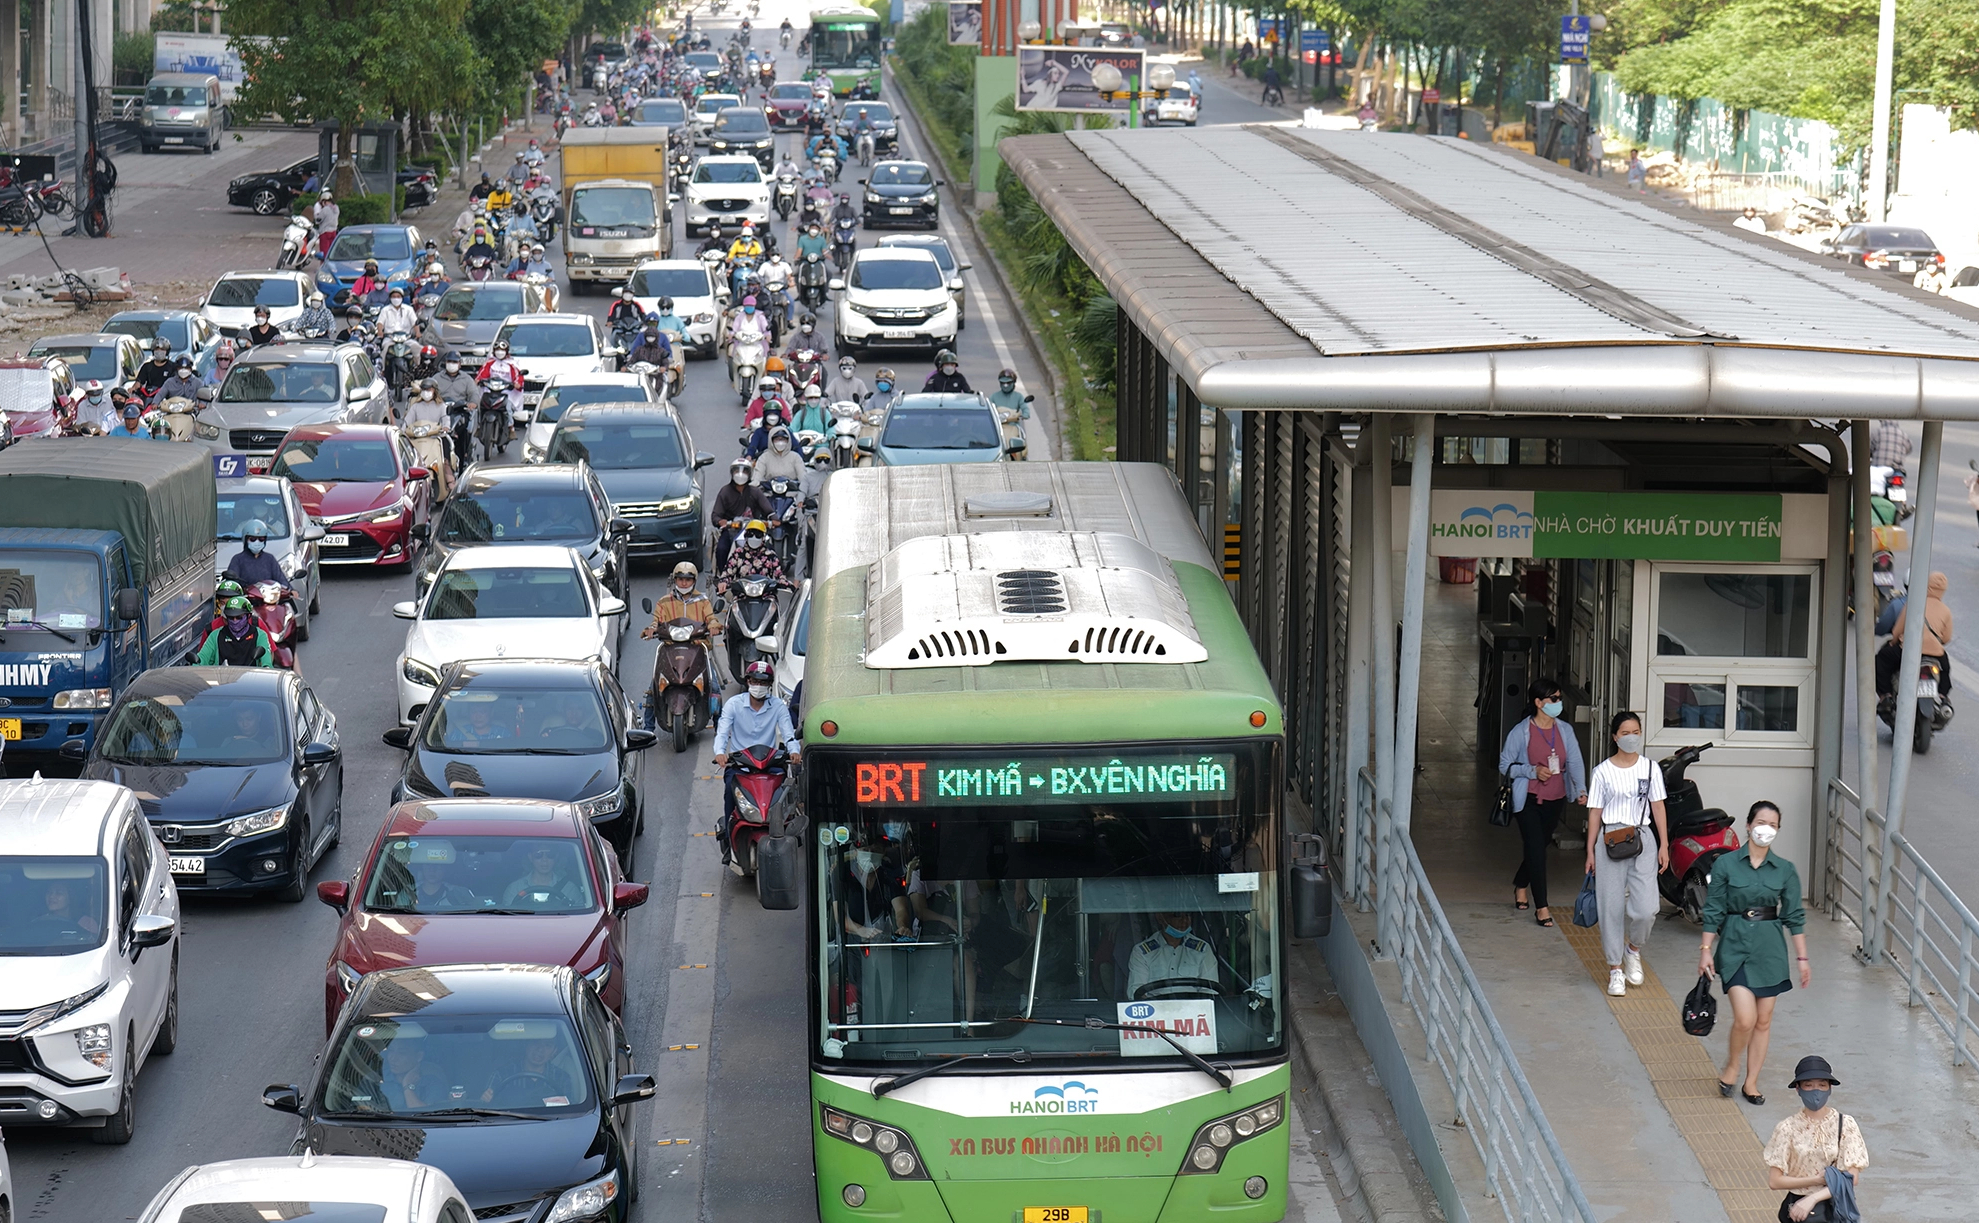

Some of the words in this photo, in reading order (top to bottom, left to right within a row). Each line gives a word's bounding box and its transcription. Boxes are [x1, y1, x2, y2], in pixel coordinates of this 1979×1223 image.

[219, 457, 238, 475] G7
[1433, 523, 1493, 537] HANOI
[1497, 525, 1533, 538] BRT
[1534, 514, 1571, 533] NHÀ
[1577, 513, 1616, 534] CHỜ
[1623, 514, 1690, 536] KHUẤT
[1695, 520, 1735, 537] DUY
[1739, 515, 1781, 538] TIẾN
[856, 762, 926, 802] BRT
[938, 769, 981, 796] KIM
[986, 762, 1021, 795] MÃ
[1148, 757, 1226, 792] NGHĨA
[1132, 1006, 1149, 1016] BRT
[1123, 1020, 1166, 1039] KIM
[1174, 1014, 1211, 1037] MÃ
[1010, 1101, 1064, 1113] HANOI
[1067, 1100, 1098, 1112] BRT
[981, 1138, 1016, 1155] BUS
[1022, 1136, 1088, 1154] NHANH
[1095, 1132, 1120, 1152] HÀ
[1126, 1131, 1162, 1158] NỘI
[1043, 1209, 1069, 1221] 29B
